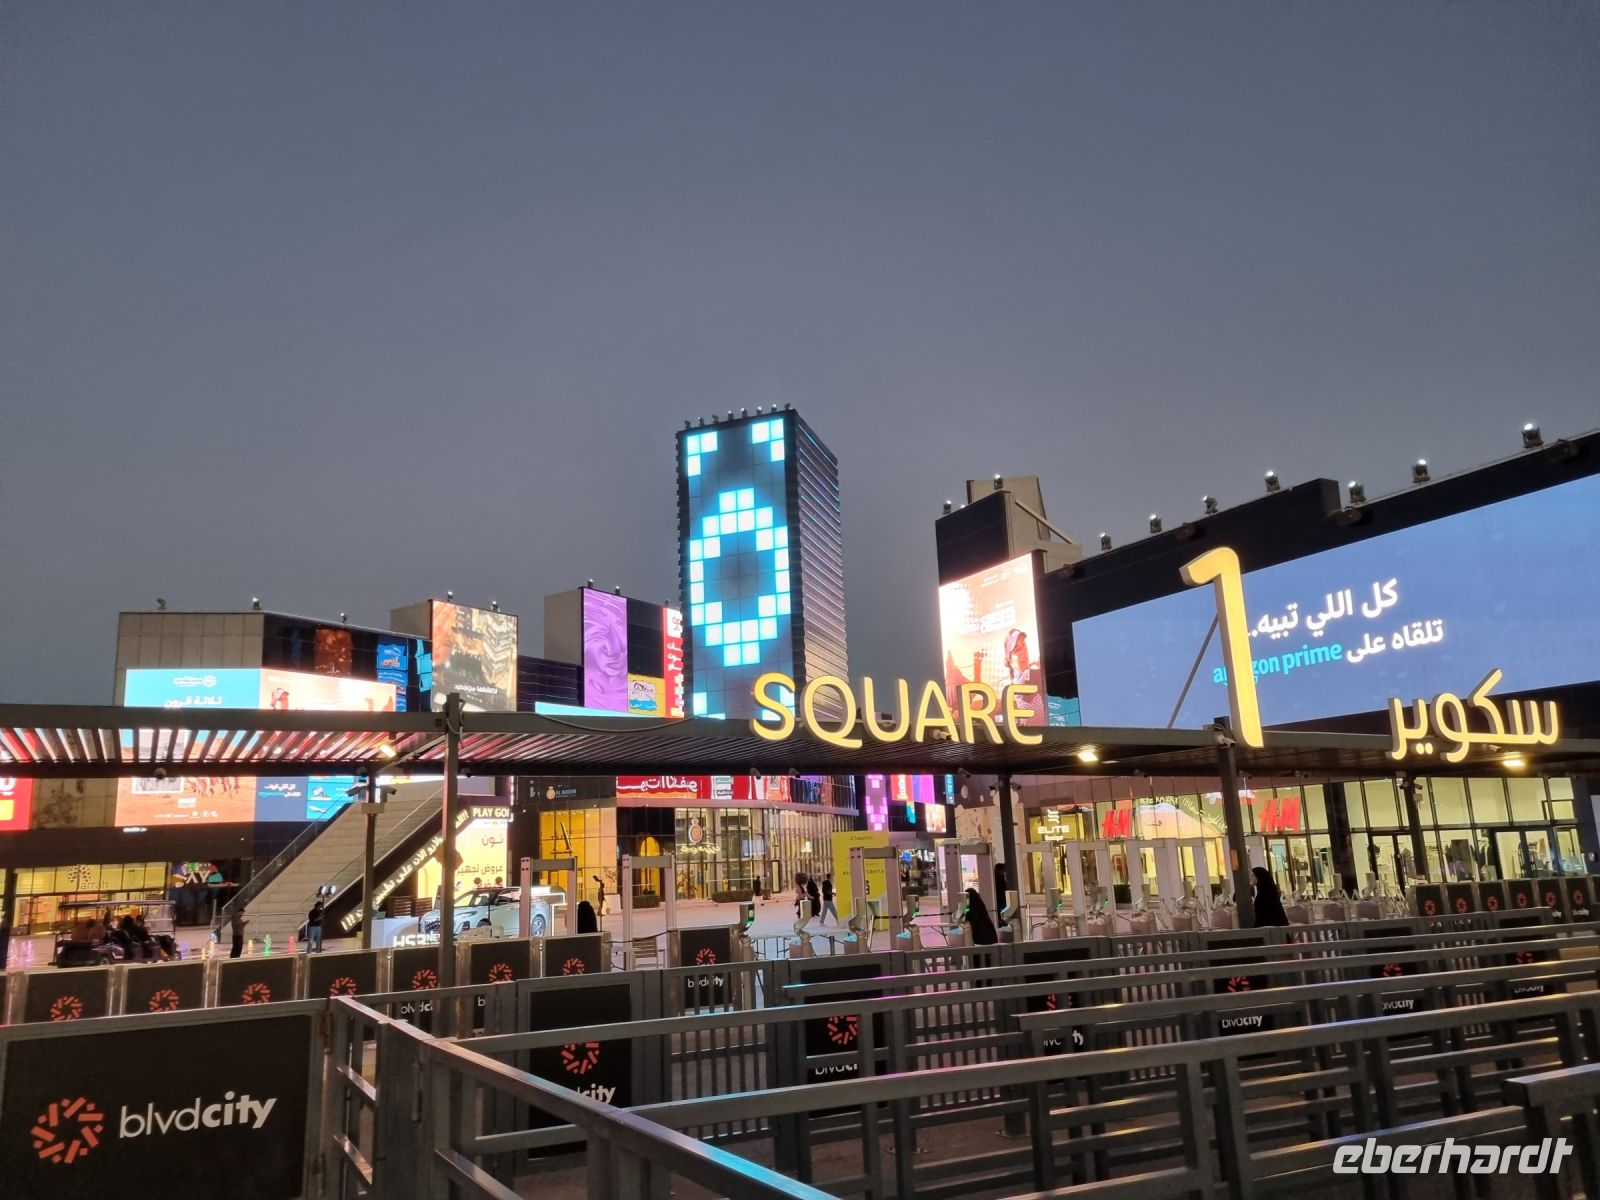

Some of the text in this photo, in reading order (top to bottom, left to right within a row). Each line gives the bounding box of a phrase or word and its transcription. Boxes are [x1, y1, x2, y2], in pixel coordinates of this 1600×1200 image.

[1306, 589, 1353, 637] اللي
[1362, 578, 1398, 617] كل
[1283, 643, 1342, 674] prime
[1347, 620, 1444, 663] تلقاه على
[752, 671, 1044, 749] SQUARE
[1390, 668, 1561, 763] سكوير
[472, 807, 494, 818] PLAY
[1102, 809, 1132, 838] H&M
[1260, 795, 1300, 833] H&M
[481, 832, 504, 848] نون
[118, 1091, 277, 1139] blvdcity
